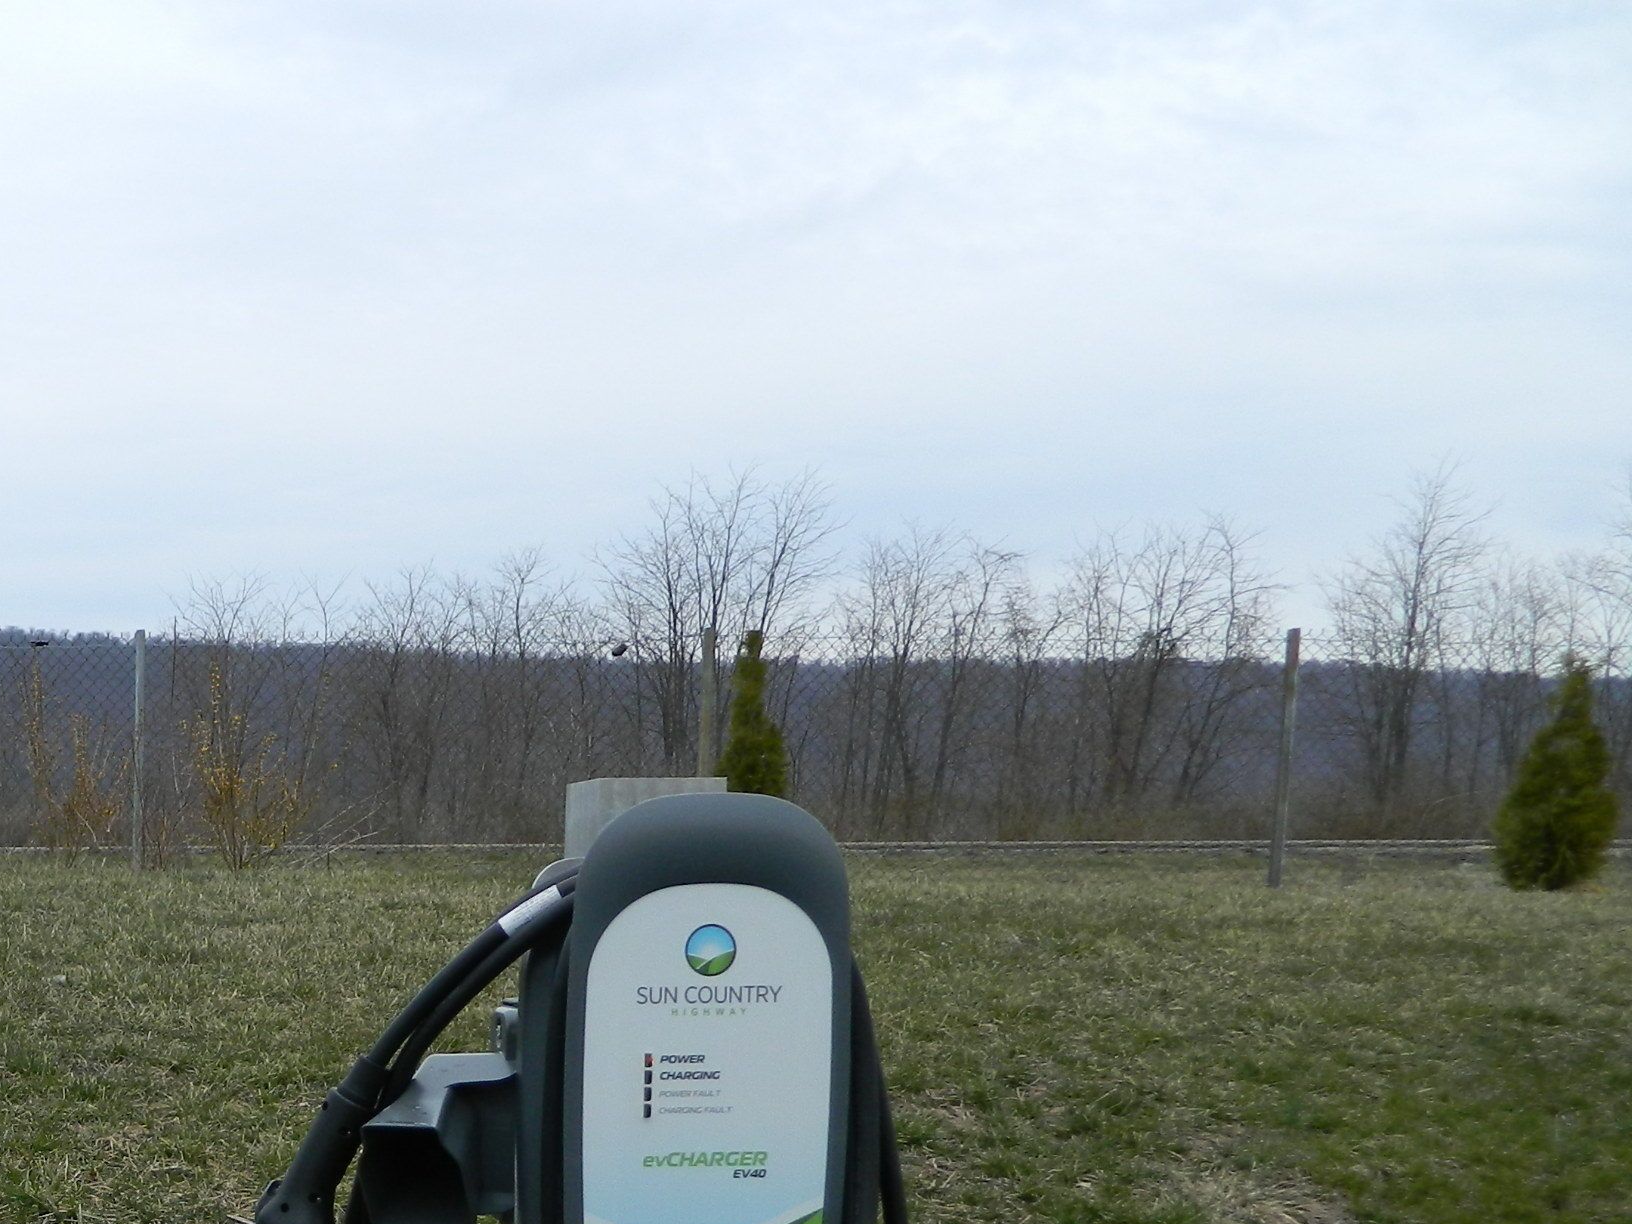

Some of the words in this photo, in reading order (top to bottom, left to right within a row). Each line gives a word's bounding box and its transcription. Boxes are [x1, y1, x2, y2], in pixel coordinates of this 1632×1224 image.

[636, 986, 678, 1005] SUN
[684, 985, 782, 1004] COUNTRY
[671, 1008, 747, 1016] HIGHWAY
[660, 1054, 705, 1064] POWER
[659, 1070, 720, 1080] CHARGING
[658, 1090, 692, 1098] POWER
[693, 1089, 722, 1097] FAULT
[658, 1106, 703, 1114] CHARGING
[704, 1106, 733, 1114] FAULT
[642, 1151, 768, 1168] evCHARGER
[732, 1168, 767, 1179] EV40
